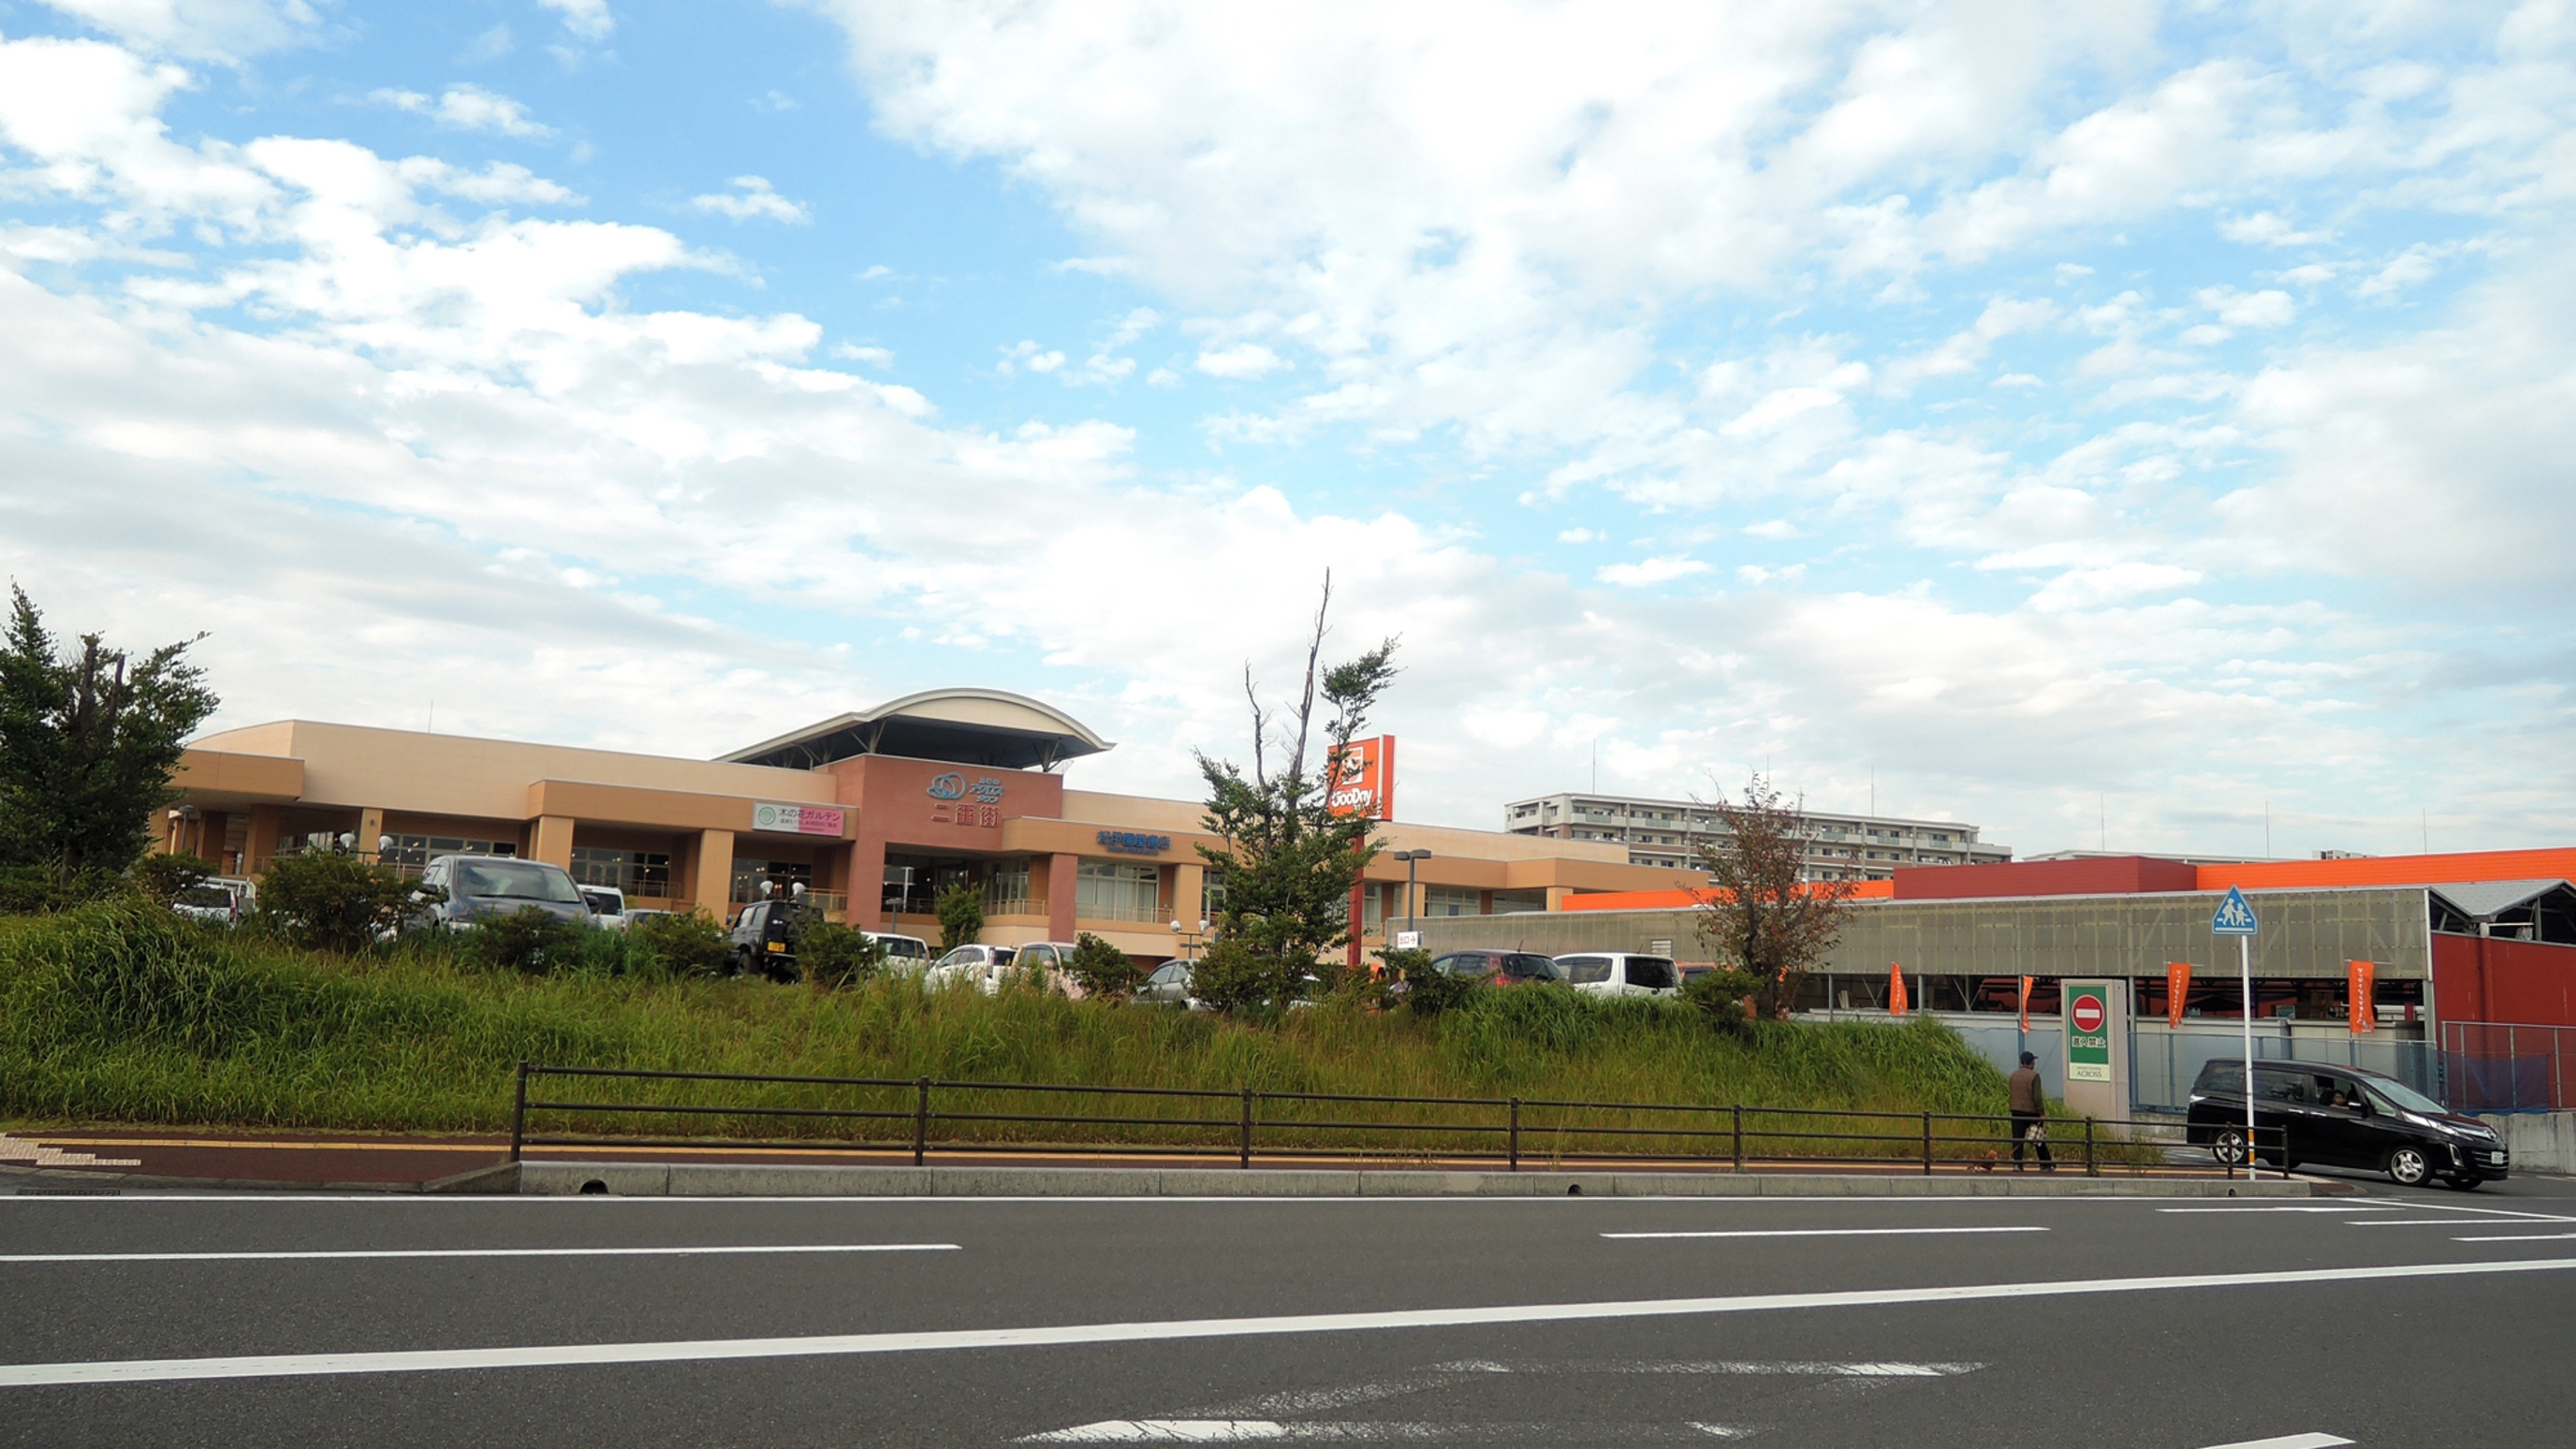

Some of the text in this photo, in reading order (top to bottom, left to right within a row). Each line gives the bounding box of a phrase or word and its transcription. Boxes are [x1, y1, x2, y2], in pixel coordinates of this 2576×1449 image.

[779, 807, 841, 822] 木の花ガルテン
[930, 803, 1000, 827] 二番街
[2071, 1035, 2106, 1048] 進入禁止
